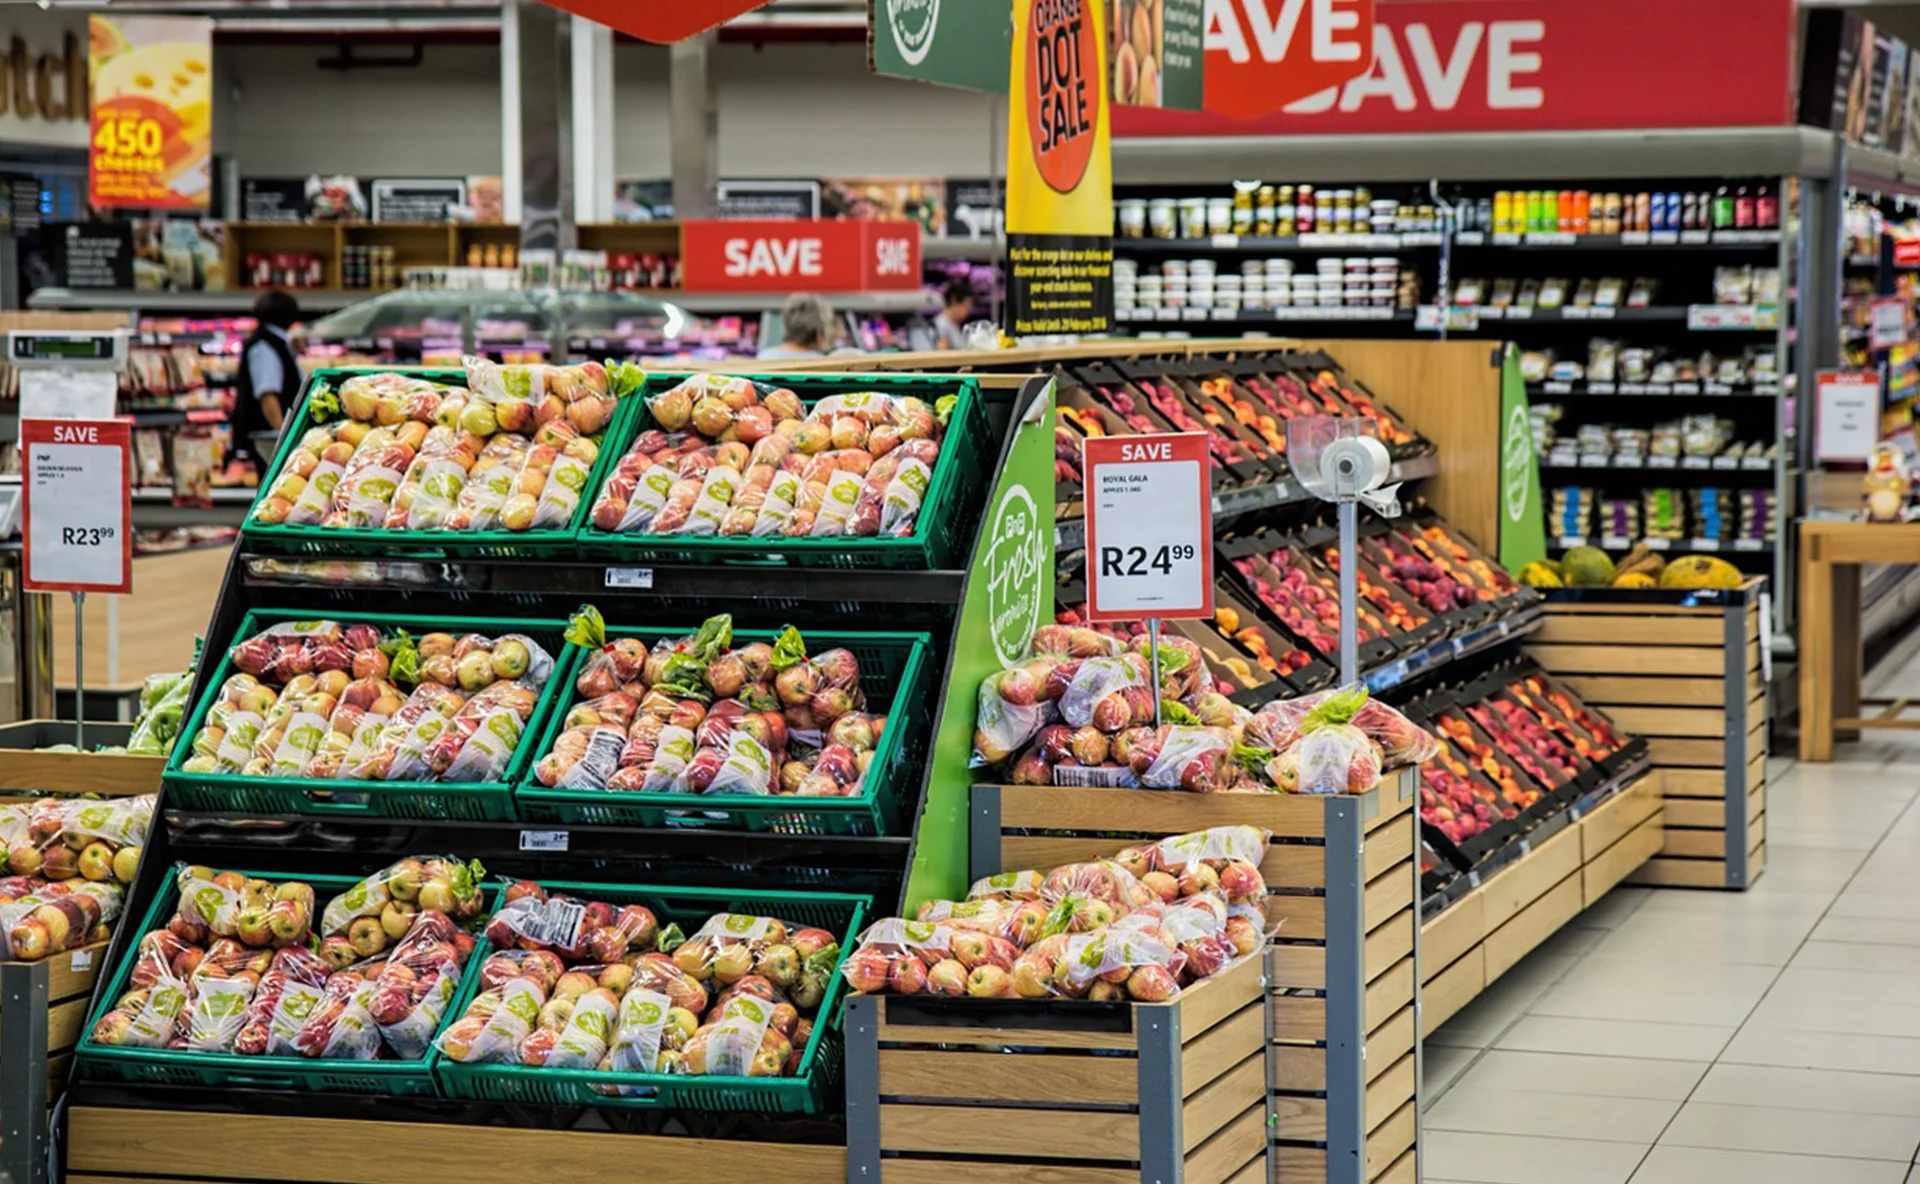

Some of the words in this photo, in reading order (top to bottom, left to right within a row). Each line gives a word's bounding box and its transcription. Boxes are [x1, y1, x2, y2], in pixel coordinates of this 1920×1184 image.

[1037, 20, 1082, 97] DOT
[1283, 21, 1544, 113] AVE
[1040, 80, 1089, 153] SALE
[94, 119, 162, 155] 450
[725, 239, 822, 276] SAVE
[876, 238, 910, 275] SAVE
[53, 426, 98, 442] SAVE
[1121, 443, 1172, 461] SAVE
[1103, 475, 1127, 483] ROYAL
[1129, 474, 1148, 482] GALA
[983, 503, 1048, 604] Fresh
